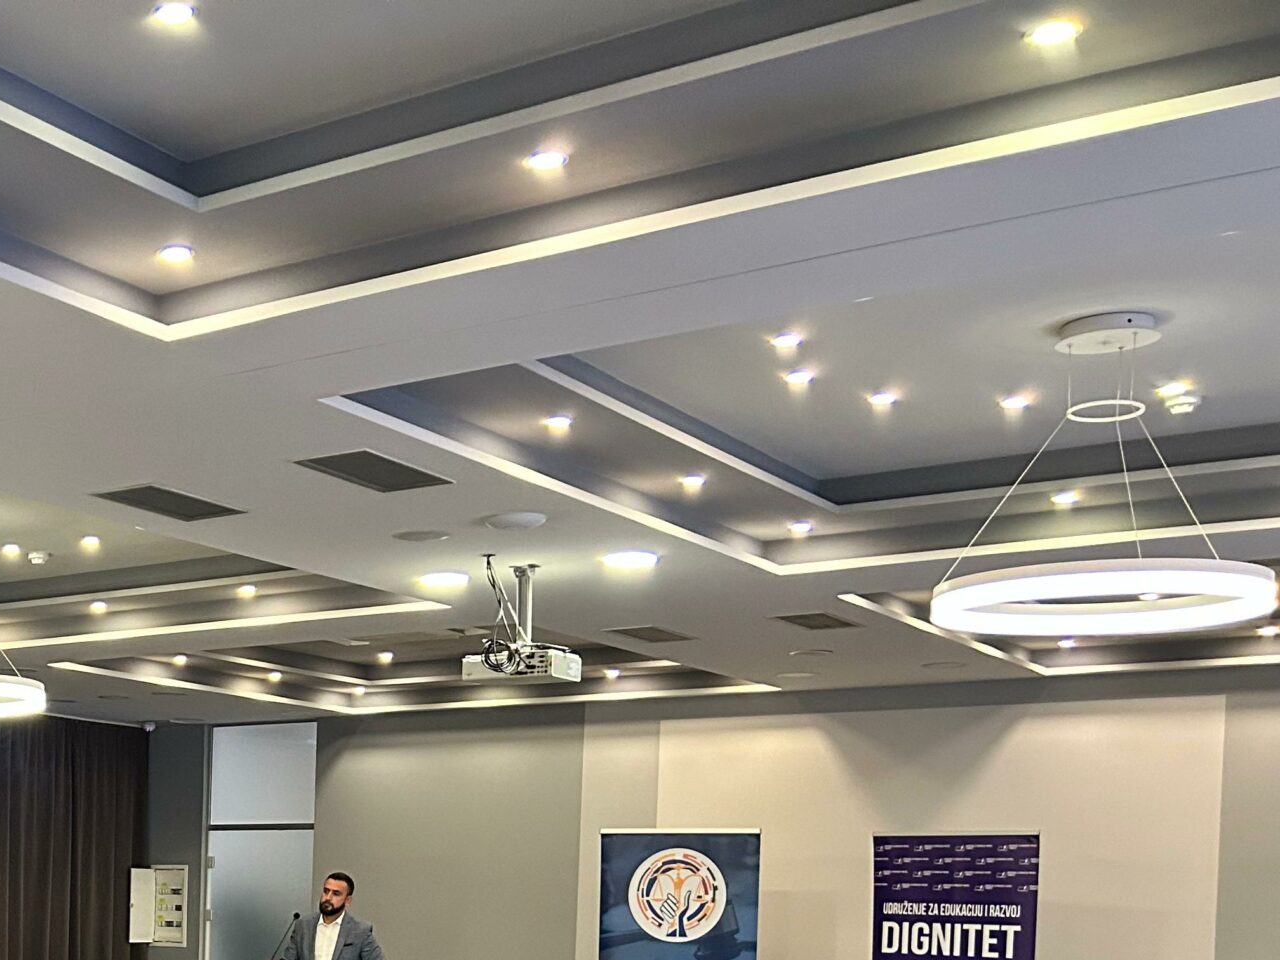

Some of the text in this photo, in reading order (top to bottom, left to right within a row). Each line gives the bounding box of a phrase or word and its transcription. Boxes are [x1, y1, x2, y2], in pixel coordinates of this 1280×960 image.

[883, 901, 926, 915] UDRUŽENJE
[928, 903, 939, 915] ZA
[940, 903, 983, 917] EDUKACIJU
[989, 904, 1021, 918] RAZVOJ
[881, 920, 1022, 959] DIGNITET
